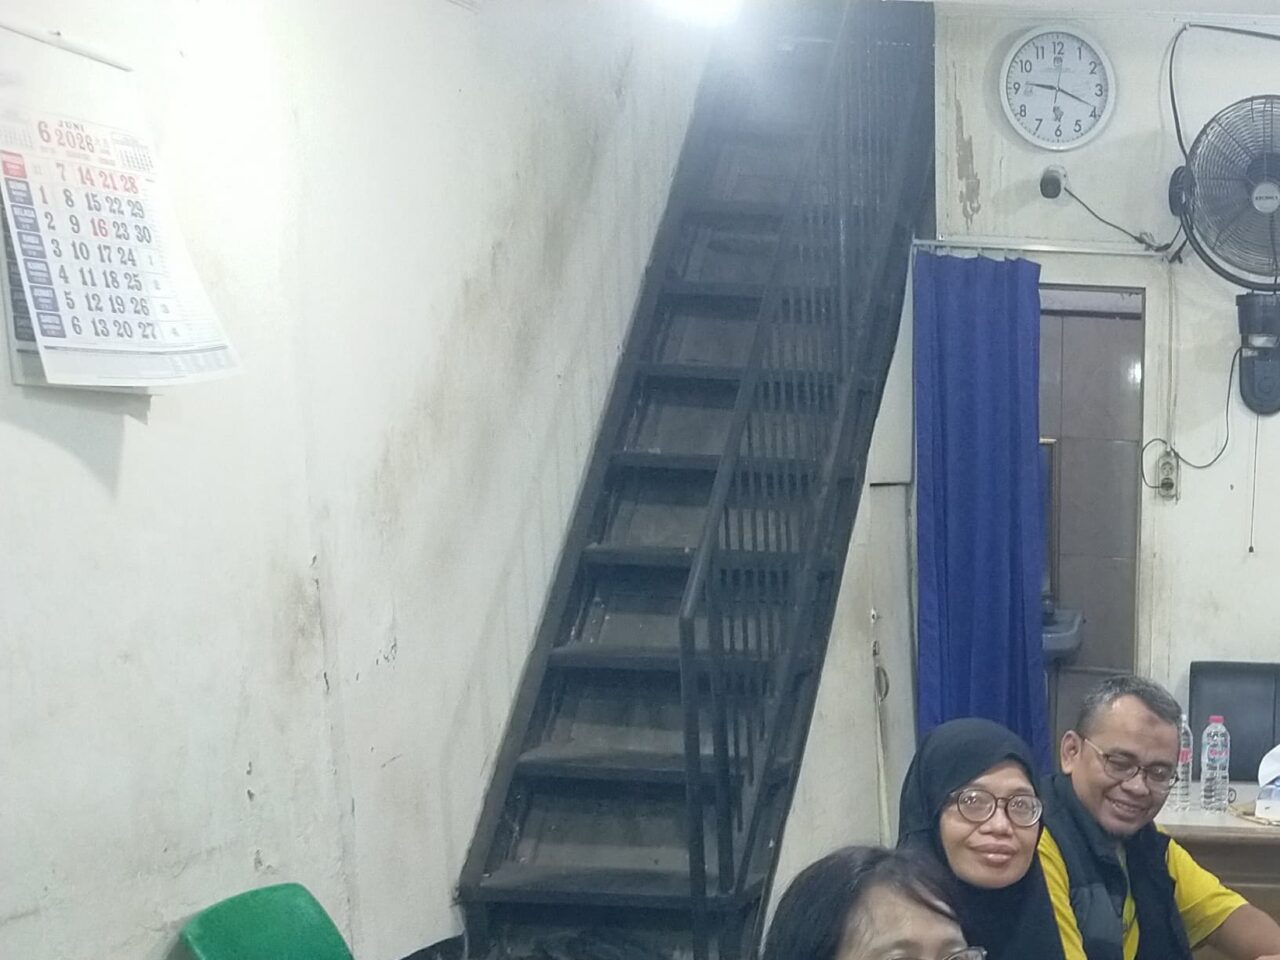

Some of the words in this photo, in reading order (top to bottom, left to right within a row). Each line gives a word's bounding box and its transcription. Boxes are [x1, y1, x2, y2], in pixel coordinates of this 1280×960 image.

[1035, 46, 1045, 60] 11
[1052, 41, 1064, 55] 12
[1020, 60, 1032, 73] 10
[1089, 61, 1097, 75] 2
[1013, 82, 1021, 95] 9
[1094, 83, 1103, 97] 3
[1020, 104, 1027, 117] 8
[1089, 106, 1097, 119] 4
[59, 120, 85, 132] JUNI
[1035, 119, 1043, 132] 7
[1055, 124, 1062, 137] 6
[1073, 119, 1082, 132] 5
[38, 120, 51, 143] 6
[54, 128, 95, 153] 2026
[56, 162, 66, 182] 7
[77, 165, 96, 187] 14
[99, 170, 118, 191] 21
[120, 174, 139, 194] 28
[39, 185, 48, 205] 1
[63, 188, 75, 208] 8
[85, 192, 102, 213] 15
[105, 195, 125, 216] 22
[127, 199, 145, 219] 29
[44, 211, 56, 231] 2
[69, 214, 81, 234] 9
[90, 217, 109, 238] 16
[112, 220, 131, 241] 23
[134, 224, 152, 244] 30
[51, 238, 63, 258] 3
[71, 240, 91, 261] 10
[97, 243, 113, 264] 17
[117, 246, 137, 267] 24
[58, 264, 70, 285] 4
[79, 266, 97, 287] 11
[102, 269, 120, 289] 18
[124, 272, 143, 292] 25
[64, 290, 76, 310] 5
[85, 292, 104, 313] 12
[109, 294, 126, 314] 19
[130, 296, 150, 316] 26
[72, 315, 83, 335] 6
[91, 317, 110, 337] 13
[113, 318, 133, 339] 20
[138, 321, 157, 340] 27
